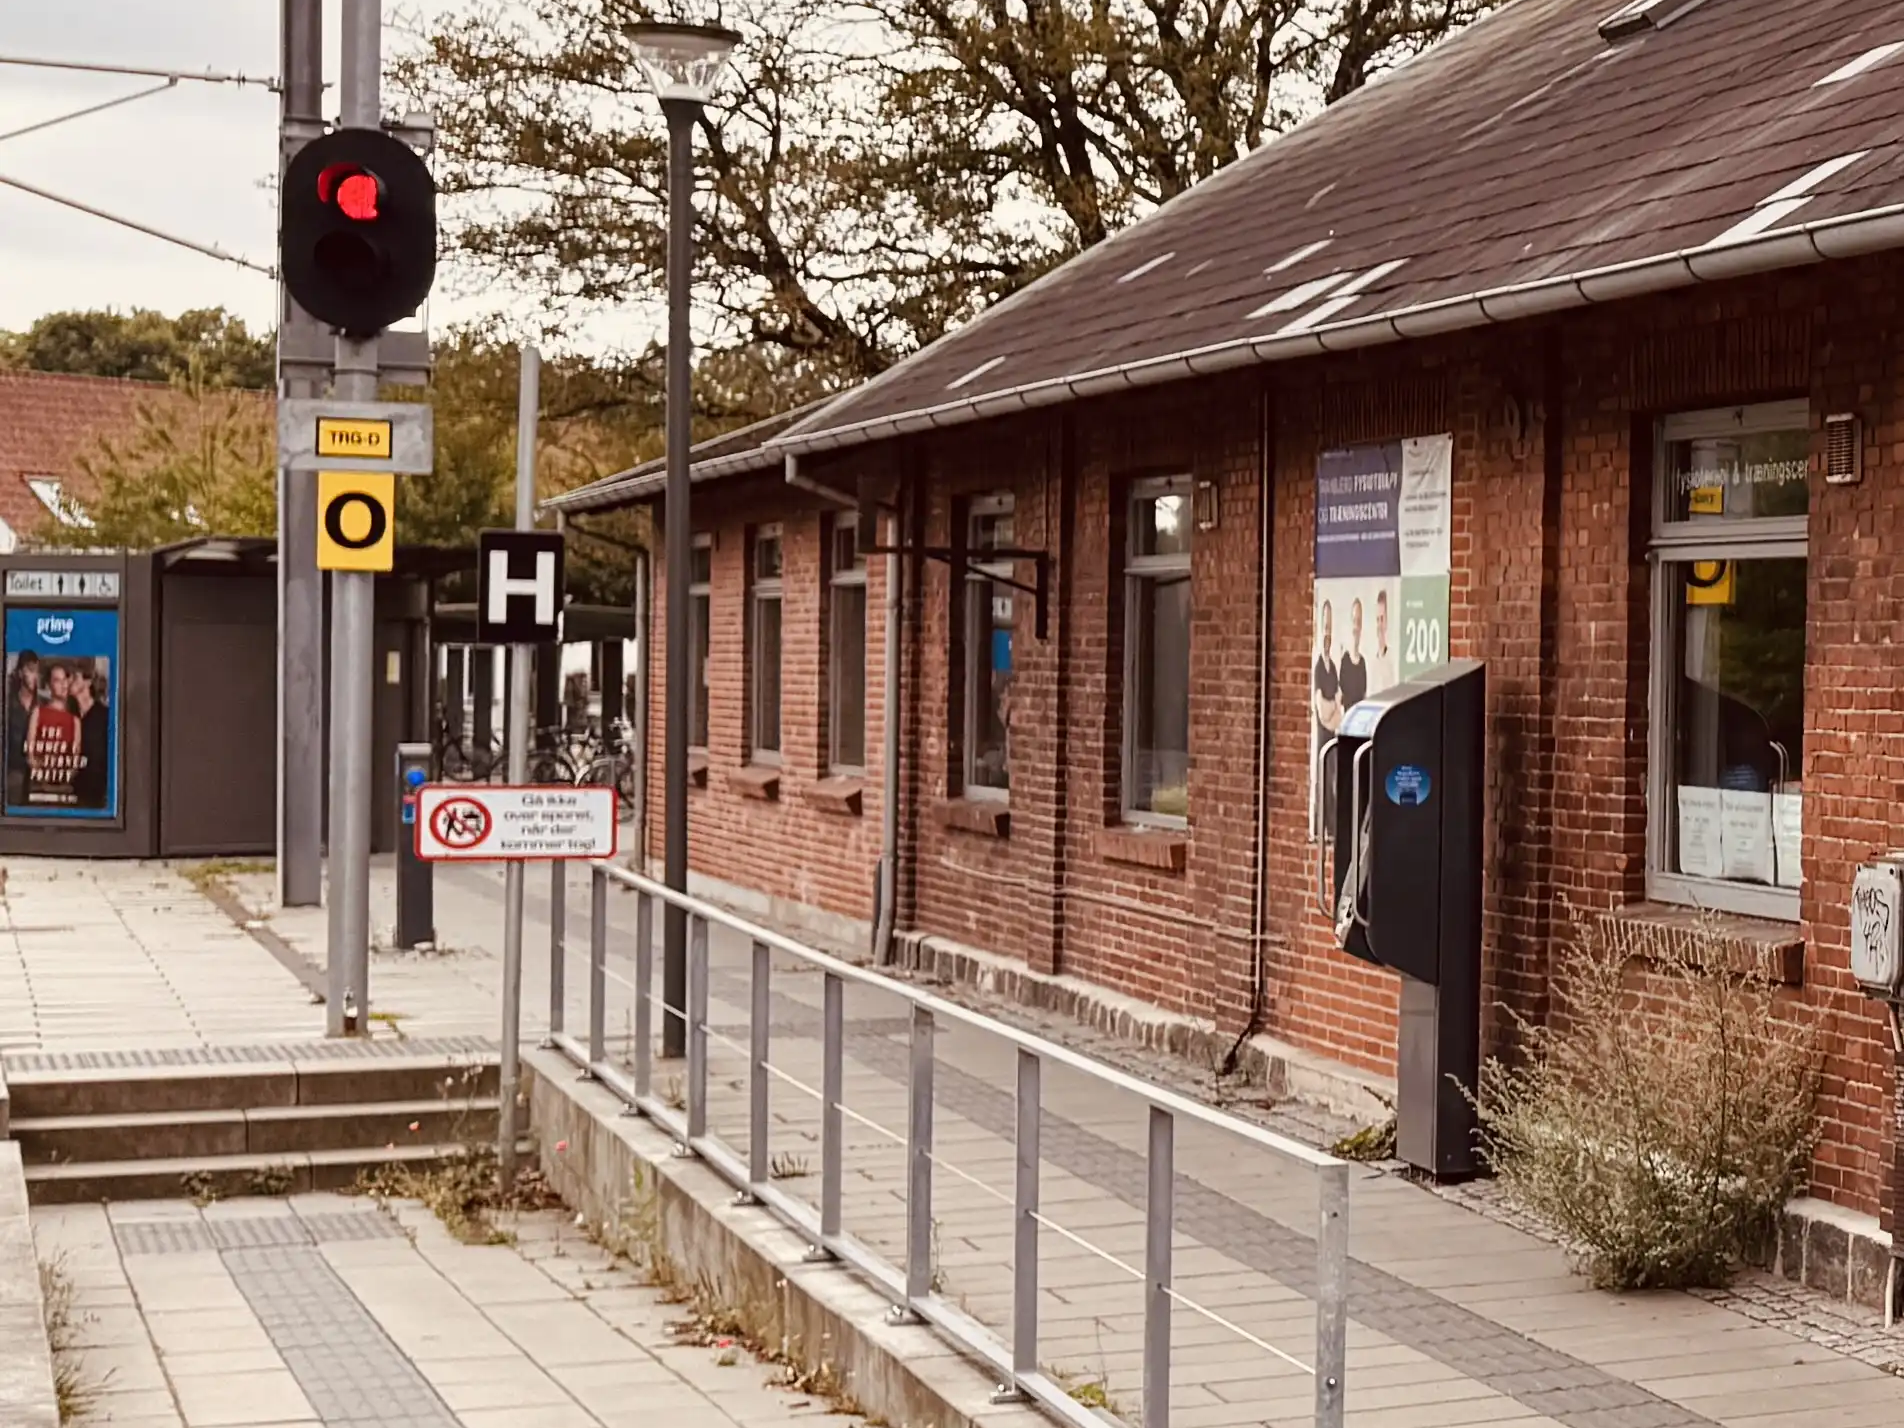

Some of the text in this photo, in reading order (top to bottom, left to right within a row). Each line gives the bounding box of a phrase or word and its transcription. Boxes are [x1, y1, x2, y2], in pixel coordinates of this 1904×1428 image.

[325, 492, 386, 549] O
[9, 572, 43, 591] Toilet
[488, 550, 555, 625] H
[1406, 618, 1440, 662] 200
